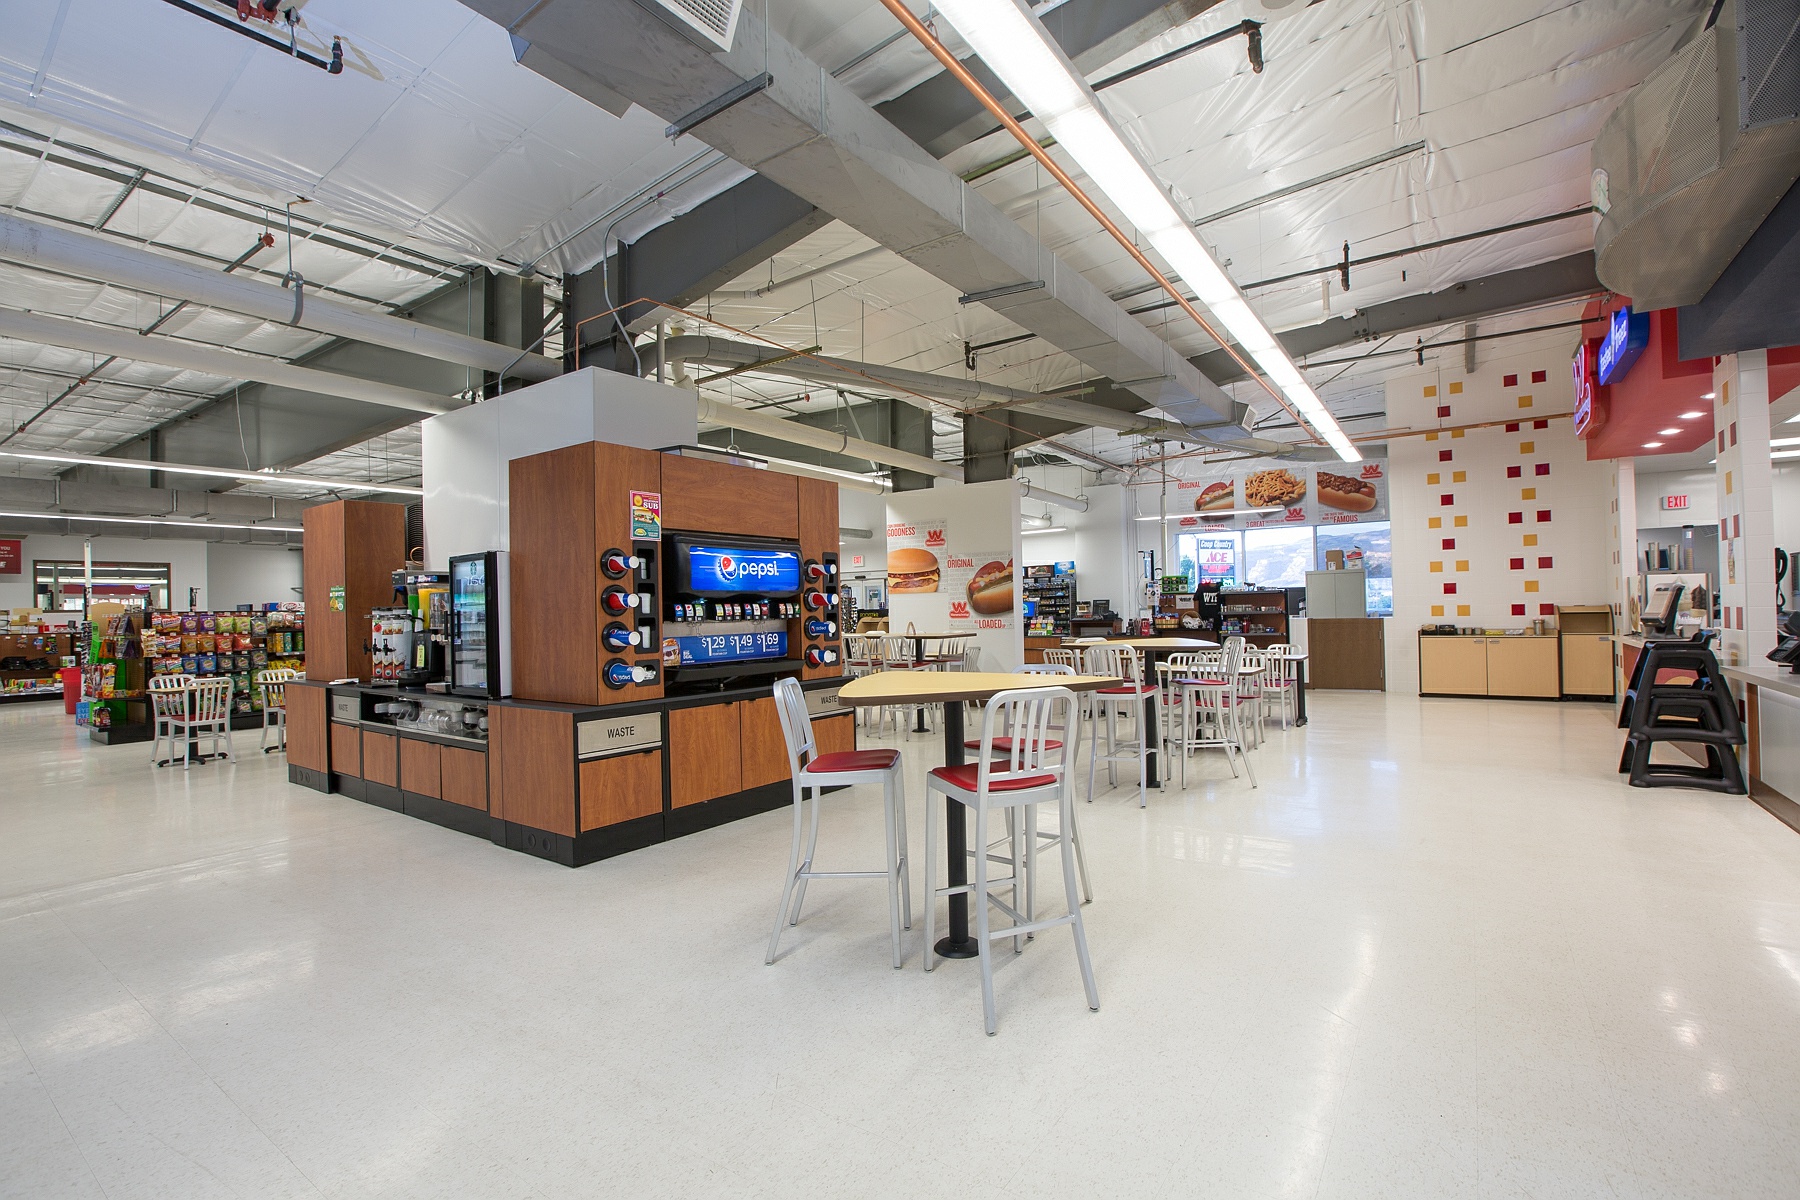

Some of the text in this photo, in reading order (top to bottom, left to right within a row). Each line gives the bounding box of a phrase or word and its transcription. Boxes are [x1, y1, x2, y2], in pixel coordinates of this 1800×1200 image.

[1178, 481, 1200, 490] ORIGINAL
[643, 502, 659, 510] SUB
[1667, 495, 1687, 508] EXIT
[1333, 514, 1358, 523] FAMOUS
[887, 527, 916, 538] GOODNESS
[927, 529, 944, 541] W
[854, 555, 862, 564] EXIT
[1206, 551, 1228, 563] ACE
[948, 559, 974, 569] ORIGINAL
[739, 561, 777, 580] pepsi
[952, 601, 967, 612] W
[979, 619, 1002, 629] LOADED
[702, 637, 726, 657] $1.29
[730, 635, 753, 655] $1.49
[757, 633, 779, 653] $1.69
[820, 695, 838, 705] WASTE
[607, 726, 635, 739] WASTE
